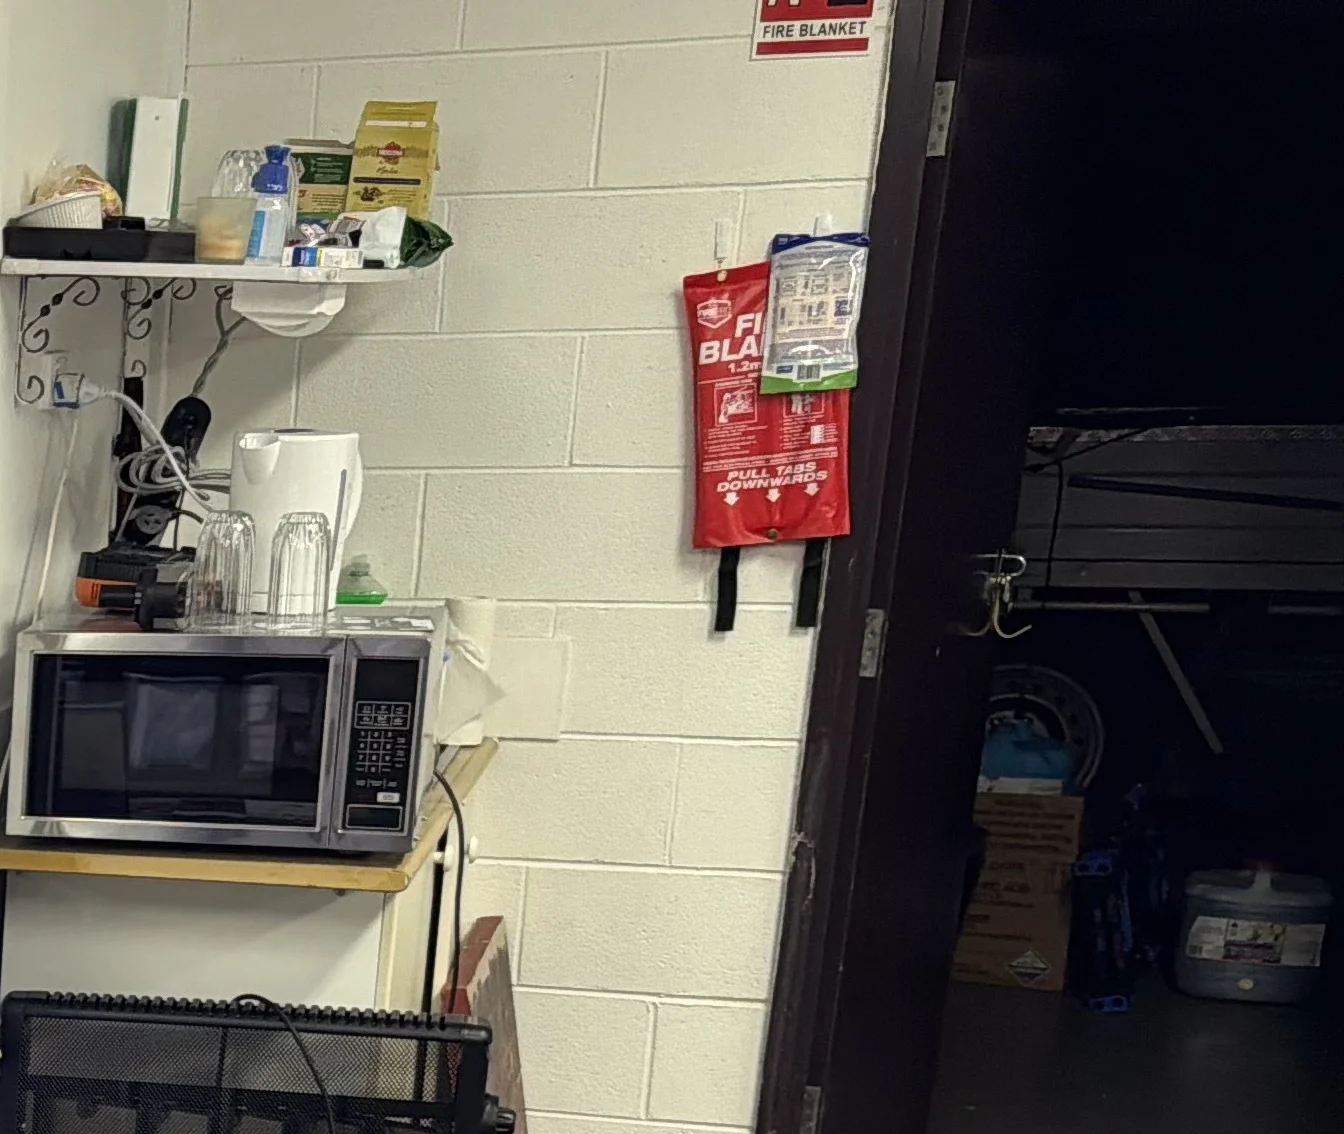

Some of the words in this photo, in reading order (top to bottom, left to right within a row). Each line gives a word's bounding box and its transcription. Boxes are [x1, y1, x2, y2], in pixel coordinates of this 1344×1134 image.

[762, 24, 795, 39] FIRE
[798, 20, 867, 37] BLANKET
[734, 312, 763, 338] FI
[716, 470, 829, 493] DOWNWARDS
[727, 468, 770, 481] PULL
[776, 461, 817, 476] TABS
